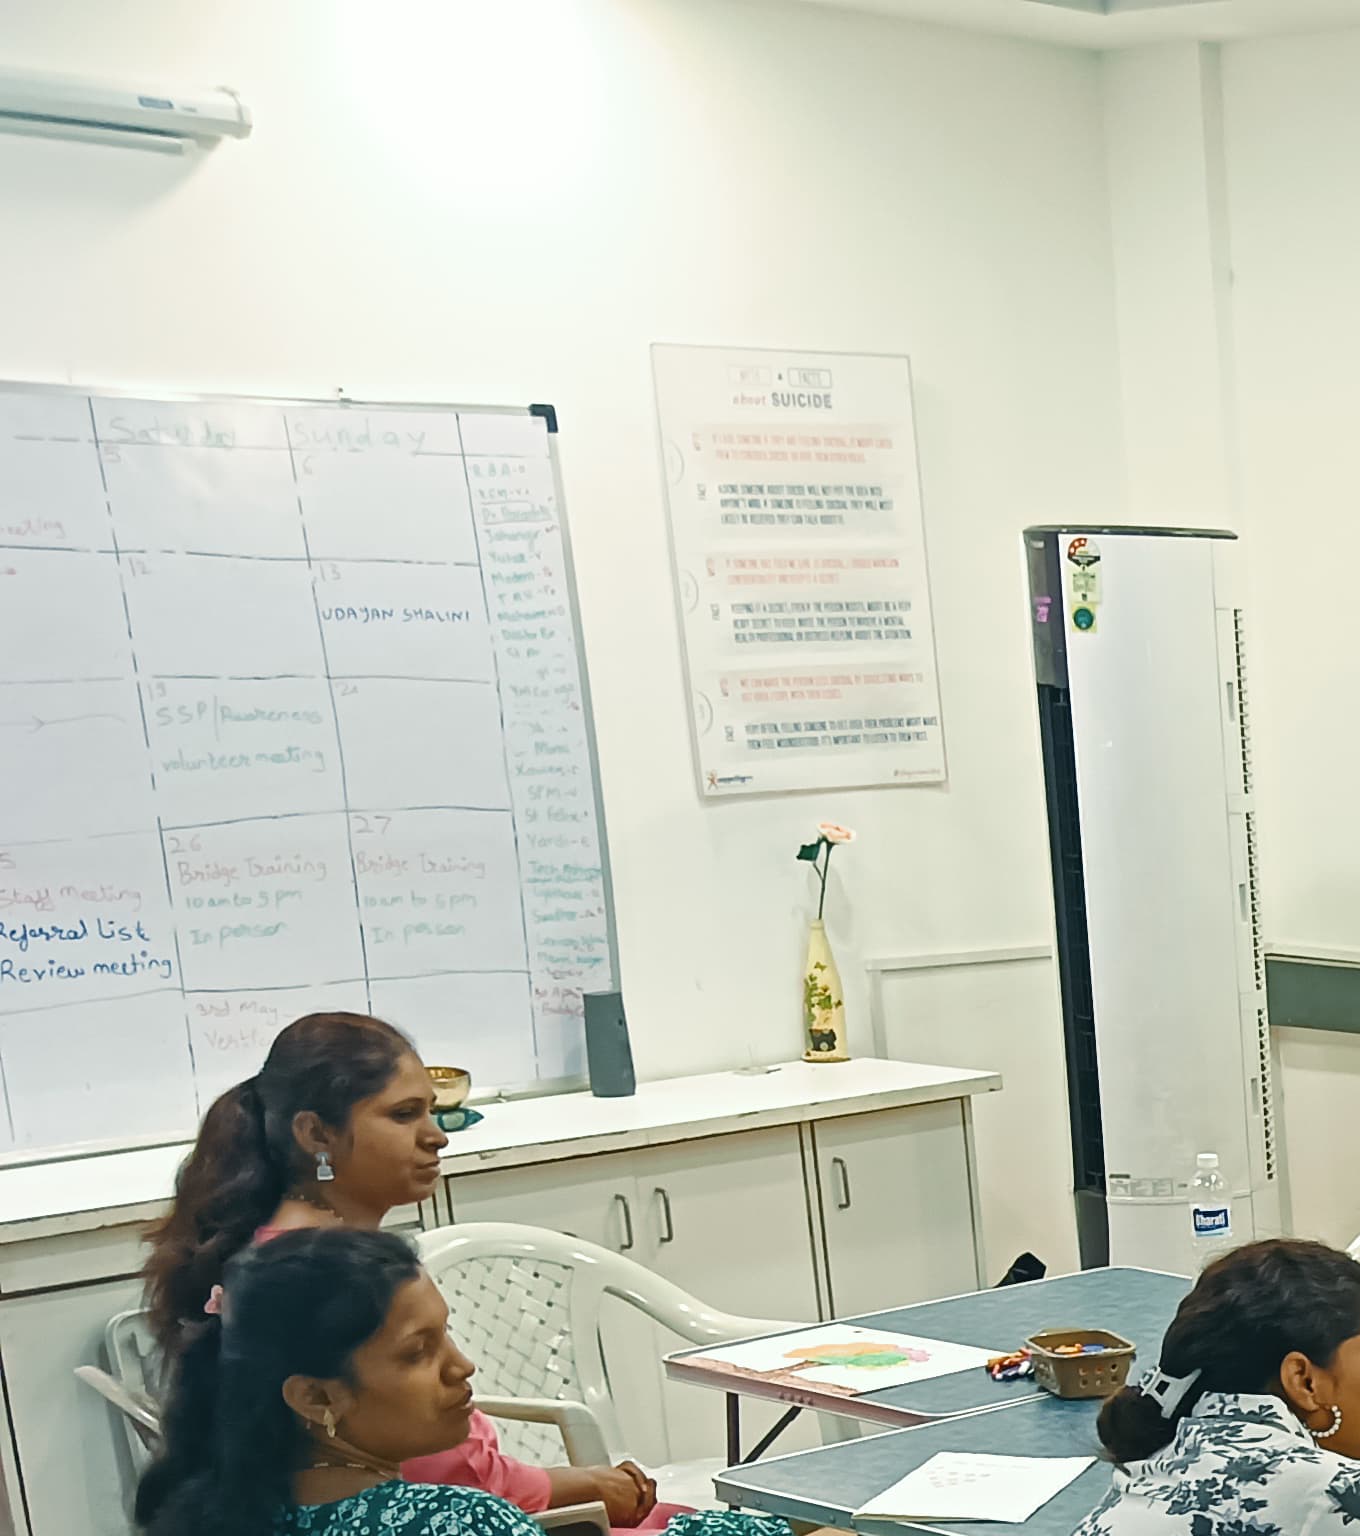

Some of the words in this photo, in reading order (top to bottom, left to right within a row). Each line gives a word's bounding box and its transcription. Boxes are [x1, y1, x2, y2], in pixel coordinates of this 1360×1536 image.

[772, 392, 832, 409] SUICIDE
[322, 609, 395, 624] UDAYAN
[402, 607, 470, 622] SHALINI
[352, 815, 392, 834] 27
[97, 918, 150, 941] list
[0, 959, 85, 982] Review
[94, 950, 171, 979] meeting
